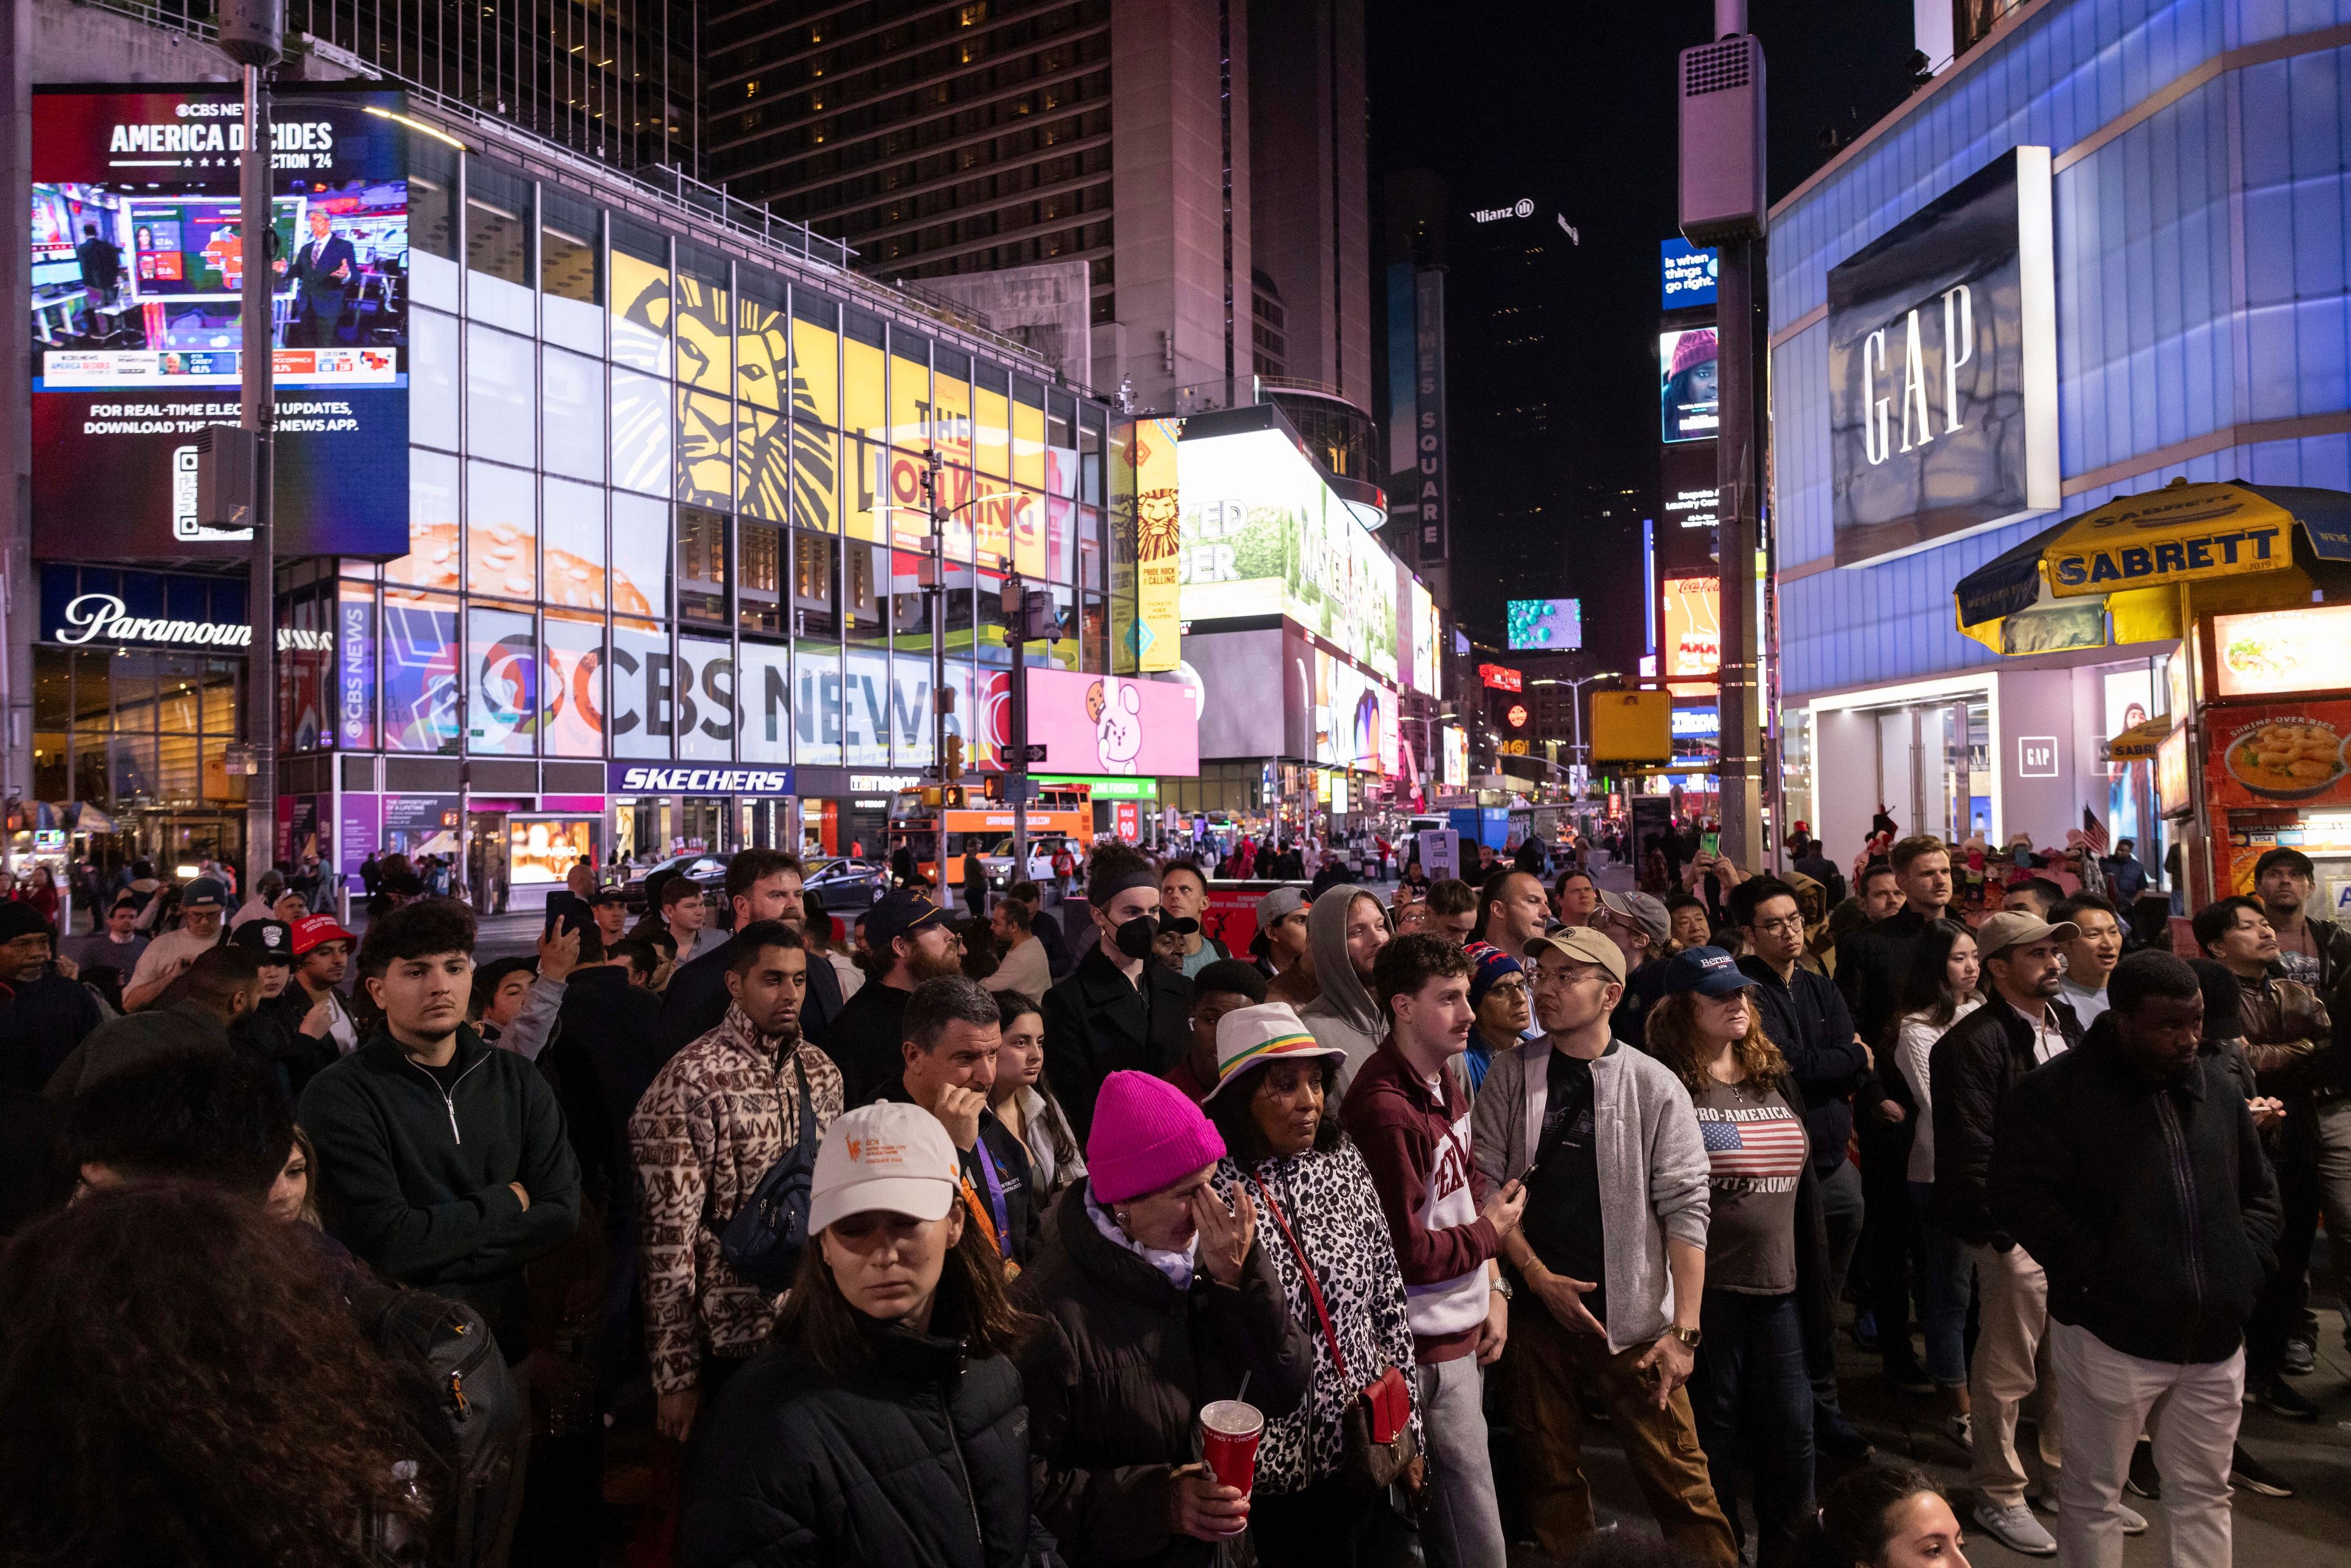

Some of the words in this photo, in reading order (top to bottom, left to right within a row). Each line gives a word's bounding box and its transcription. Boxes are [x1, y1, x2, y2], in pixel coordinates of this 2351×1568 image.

[190, 103, 219, 116] CBS
[110, 124, 225, 152] AMERICA
[230, 123, 333, 152] DCIDES
[270, 154, 309, 169] CTION
[313, 153, 332, 168] '24
[1665, 257, 1676, 268] is
[1676, 254, 1709, 266] when
[1665, 267, 1702, 279] things
[1665, 282, 1682, 294] go
[1684, 276, 1715, 290] right.
[1864, 284, 1973, 466] GAP
[90, 404, 122, 418] FOR
[124, 403, 204, 417] REAL-TIME
[283, 401, 353, 416] UPDATES,
[84, 421, 175, 435] DOWNLOAD
[177, 421, 205, 433] THE
[280, 420, 325, 432] NEWS
[326, 419, 359, 432] APP.
[915, 399, 972, 449] THE
[1420, 411, 1439, 544] SQUARE
[952, 458, 1034, 536] KING
[2090, 493, 2235, 529] SABRETT
[2057, 523, 2279, 585] SABRETT
[2248, 561, 2271, 571] 2019
[1149, 576, 1176, 585] CALLING
[56, 593, 252, 647] Paramoun
[346, 608, 364, 673] NEWS
[346, 677, 363, 719] CBS
[573, 645, 745, 742] CBS
[2230, 718, 2271, 738] SHRIMP
[2308, 718, 2336, 733] RICE
[2027, 748, 2050, 766] GAP
[622, 767, 787, 792] SKECHERS
[872, 775, 920, 792] TISSOT
[1092, 782, 1109, 793] LINE
[1109, 782, 1139, 794] FRIENDS
[1120, 808, 1135, 817] SALE
[1120, 820, 1134, 837] 90
[2338, 886, 2351, 907] A
[1700, 955, 1733, 969] Bernie
[1709, 1176, 1797, 1193] NTI-TRUMP
